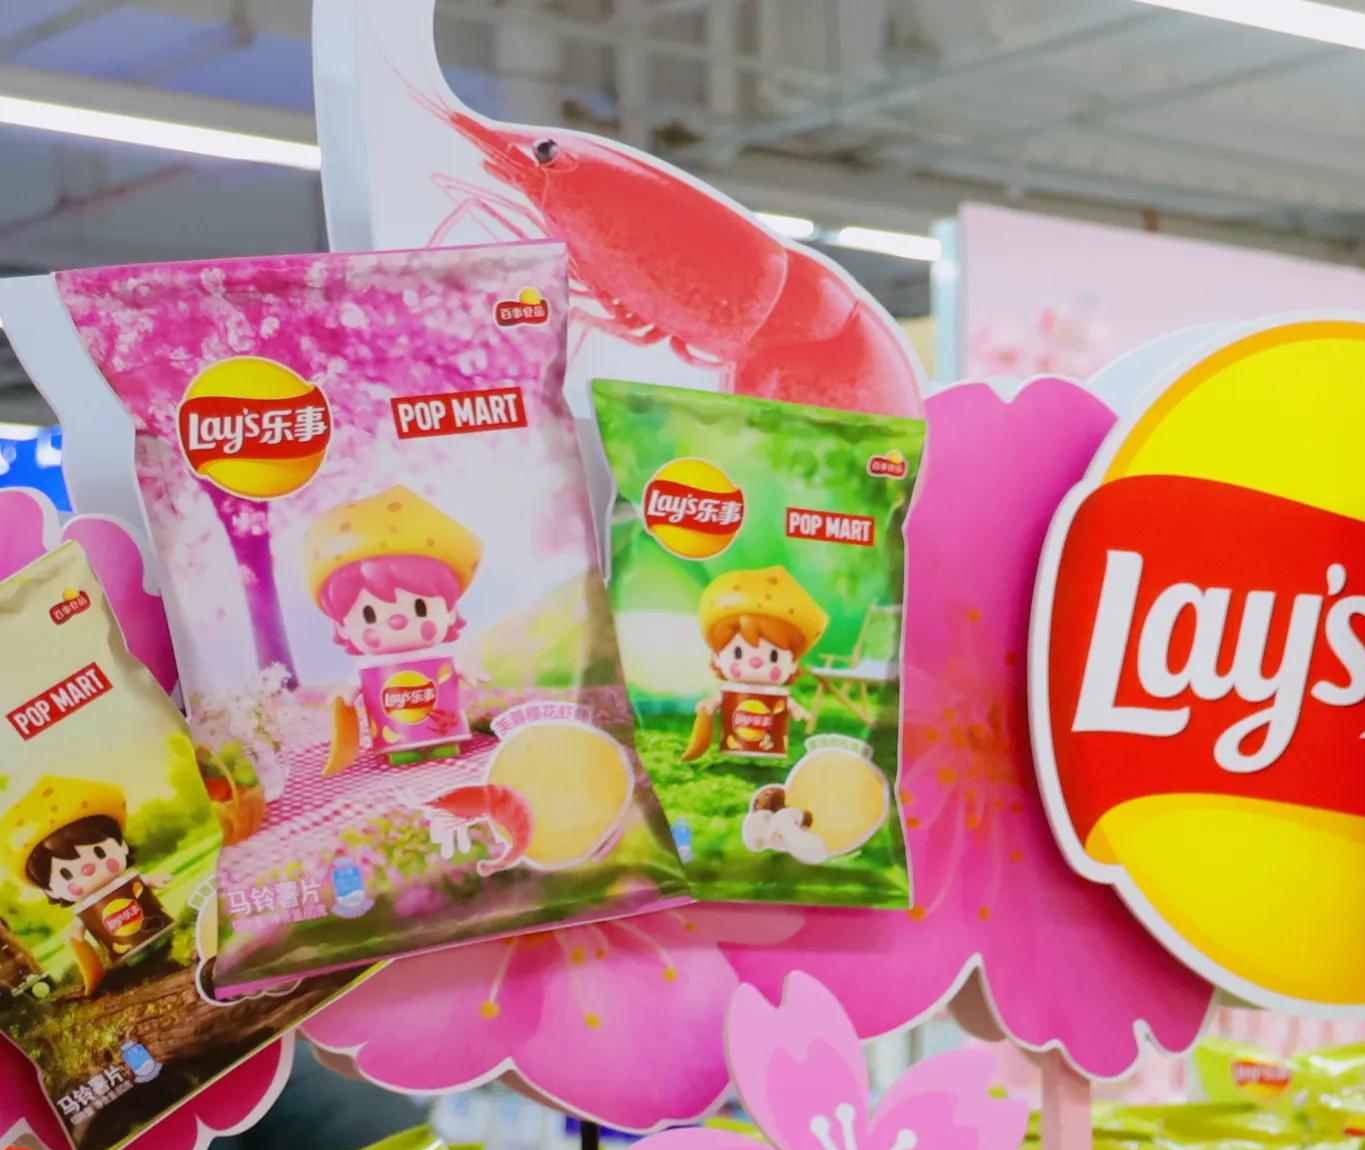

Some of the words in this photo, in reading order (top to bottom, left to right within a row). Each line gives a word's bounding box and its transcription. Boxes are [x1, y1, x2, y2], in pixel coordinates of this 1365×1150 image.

[398, 402, 450, 434] POP
[454, 393, 520, 427] MART
[789, 512, 826, 538] POP
[828, 516, 872, 543] MART
[15, 697, 57, 734] POP
[57, 670, 104, 711] MART
[228, 877, 321, 915] 马铃薯片
[57, 1065, 124, 1116] 马铃薯片
